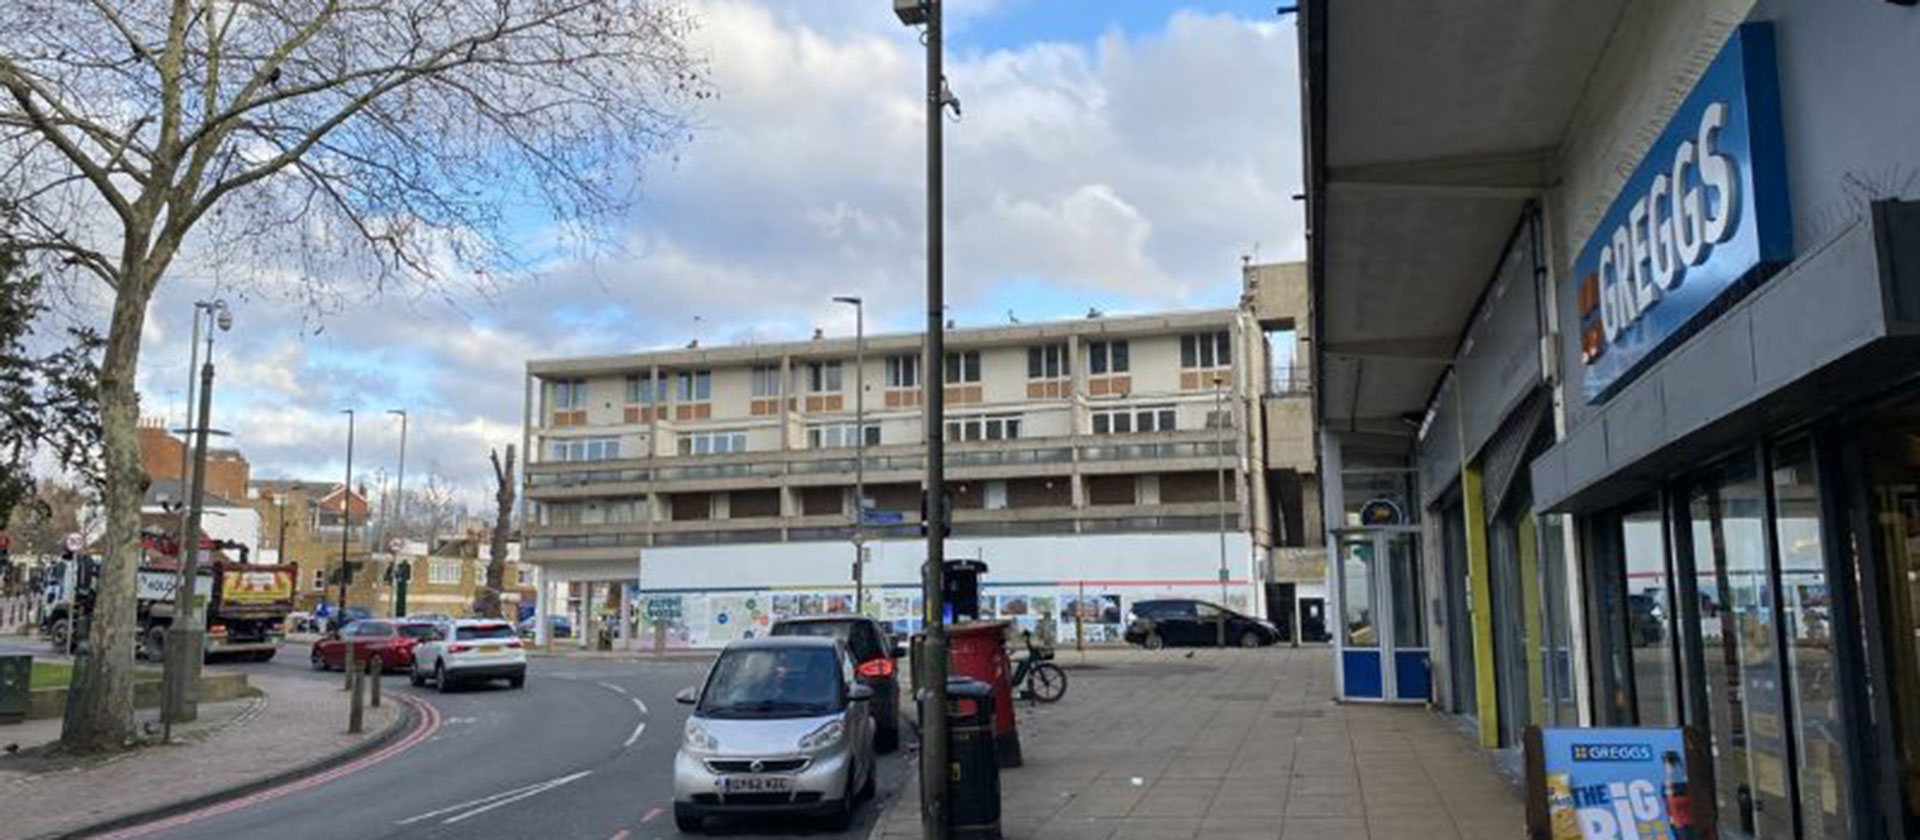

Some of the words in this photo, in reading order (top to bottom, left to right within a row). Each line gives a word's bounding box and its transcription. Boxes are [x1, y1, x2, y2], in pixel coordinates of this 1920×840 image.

[1599, 102, 1736, 341] GREGGS
[1589, 746, 1650, 760] GREGGS
[1573, 785, 1608, 806] THE
